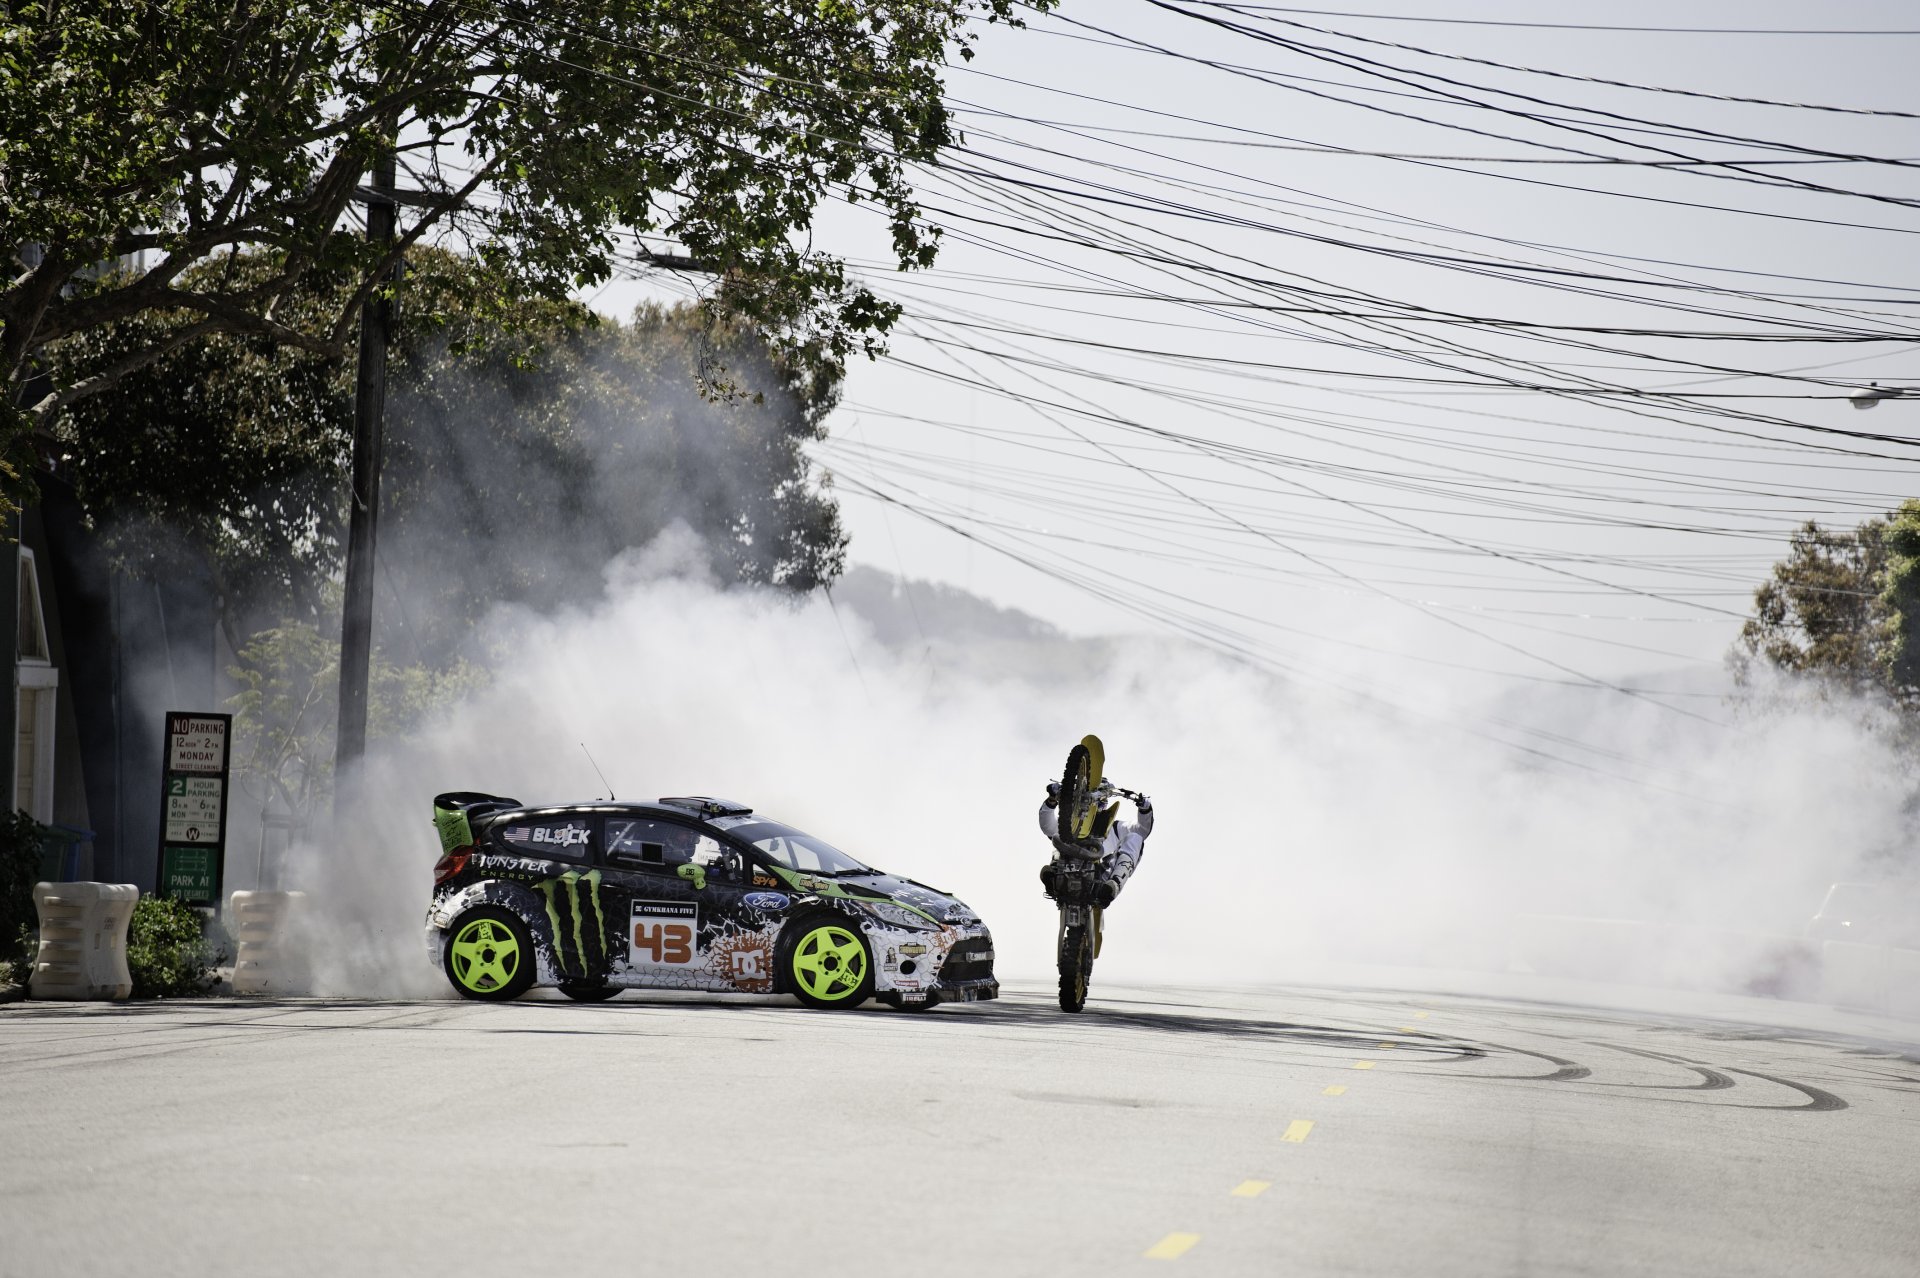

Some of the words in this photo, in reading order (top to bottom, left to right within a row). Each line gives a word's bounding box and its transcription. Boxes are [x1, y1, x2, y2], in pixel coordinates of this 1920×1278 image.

[173, 719, 188, 733] NO
[190, 723, 224, 735] PARKING
[176, 737, 185, 748] 12
[204, 738, 211, 748] 2
[179, 751, 214, 761] MONDAY
[172, 780, 183, 794] 2
[193, 781, 215, 789] HOUR
[187, 789, 220, 798] PARKING
[171, 798, 178, 809] 8
[200, 799, 206, 810] 6
[171, 811, 186, 819] MON
[203, 812, 215, 820] FRI
[187, 829, 199, 840] W
[171, 874, 194, 887] PARK
[199, 875, 210, 887] AT
[480, 870, 534, 881] ENERGY
[752, 876, 768, 887] SPY
[752, 893, 781, 910] Ford
[643, 906, 678, 915] GYMKHANA
[679, 907, 694, 915] FIVE
[634, 923, 692, 964] 43
[731, 949, 767, 981] DC
